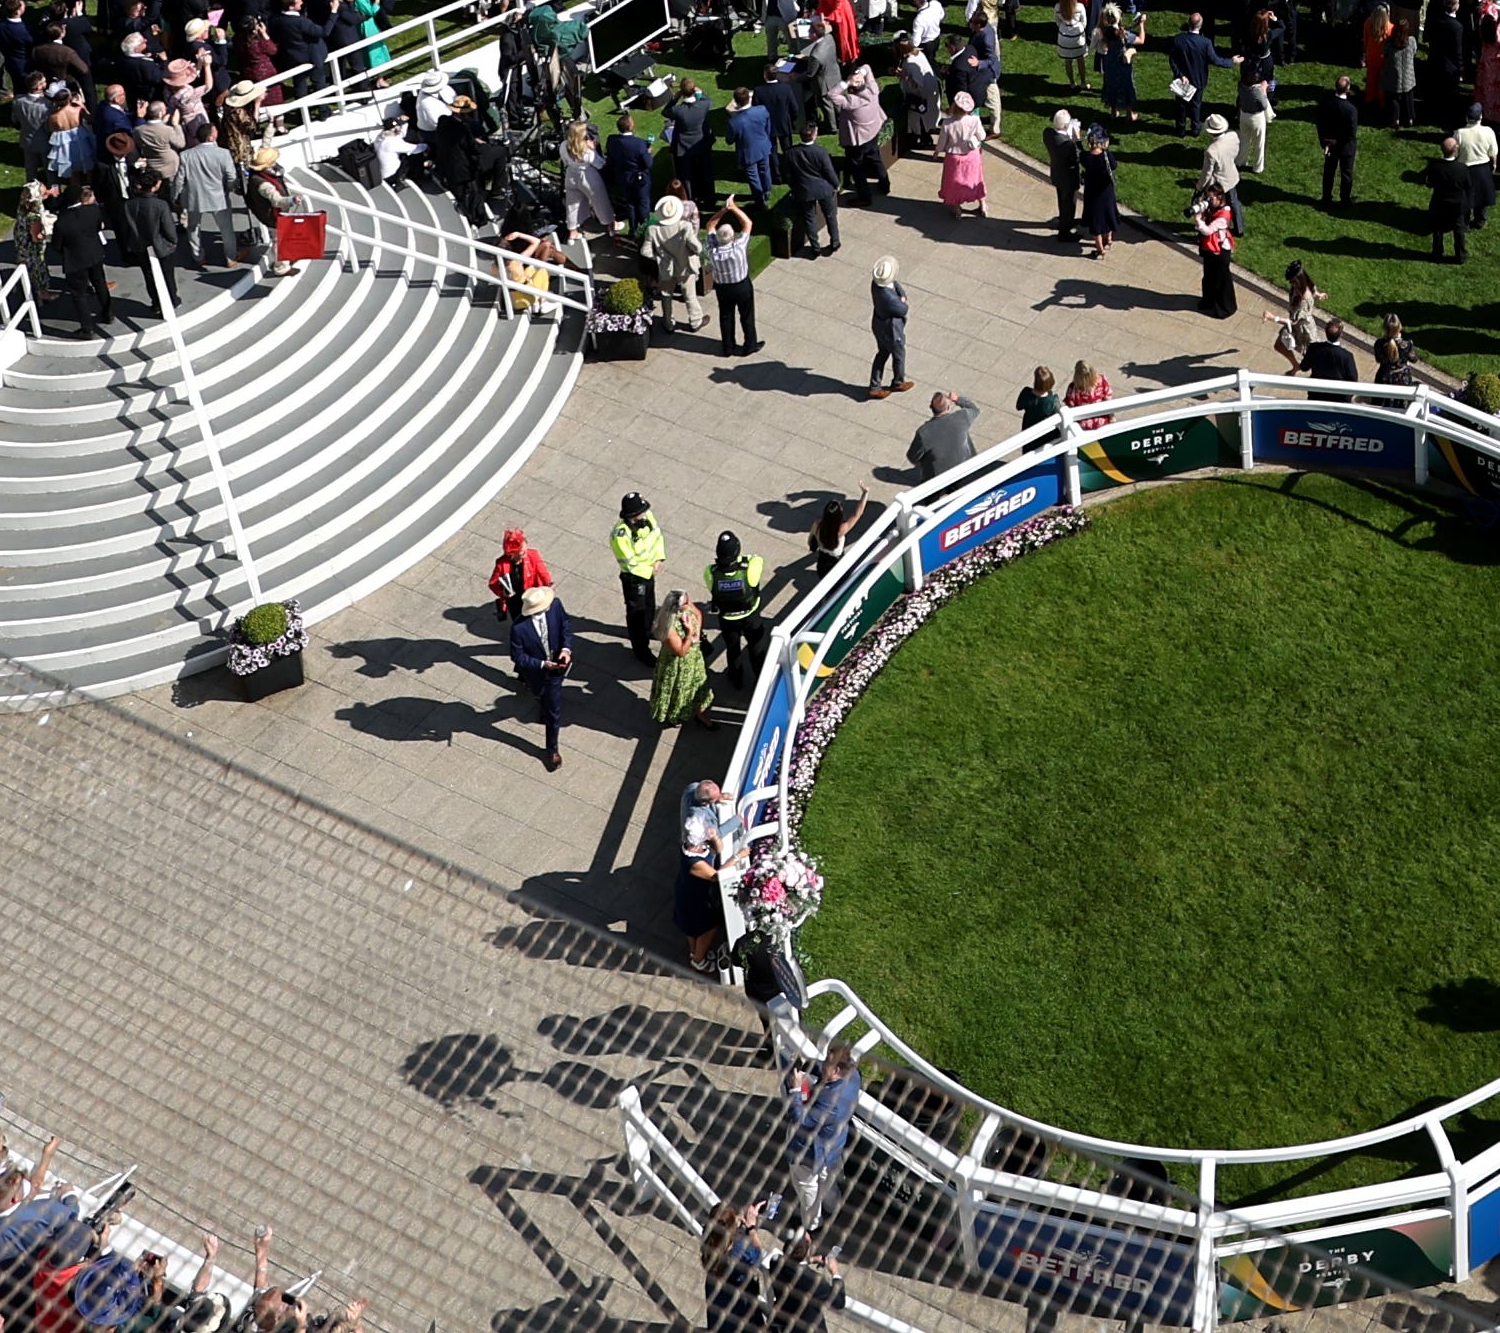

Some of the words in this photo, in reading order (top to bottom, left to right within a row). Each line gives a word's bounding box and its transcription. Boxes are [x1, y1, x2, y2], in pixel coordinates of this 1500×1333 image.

[1131, 430, 1185, 450] DERBY
[1283, 431, 1384, 453] BETFRED
[943, 486, 1037, 548] BETFRED
[719, 580, 742, 590] POLICE
[1328, 1246, 1346, 1254] THE
[1020, 1251, 1155, 1294] BETFRED
[1300, 1250, 1375, 1274] DERBY
